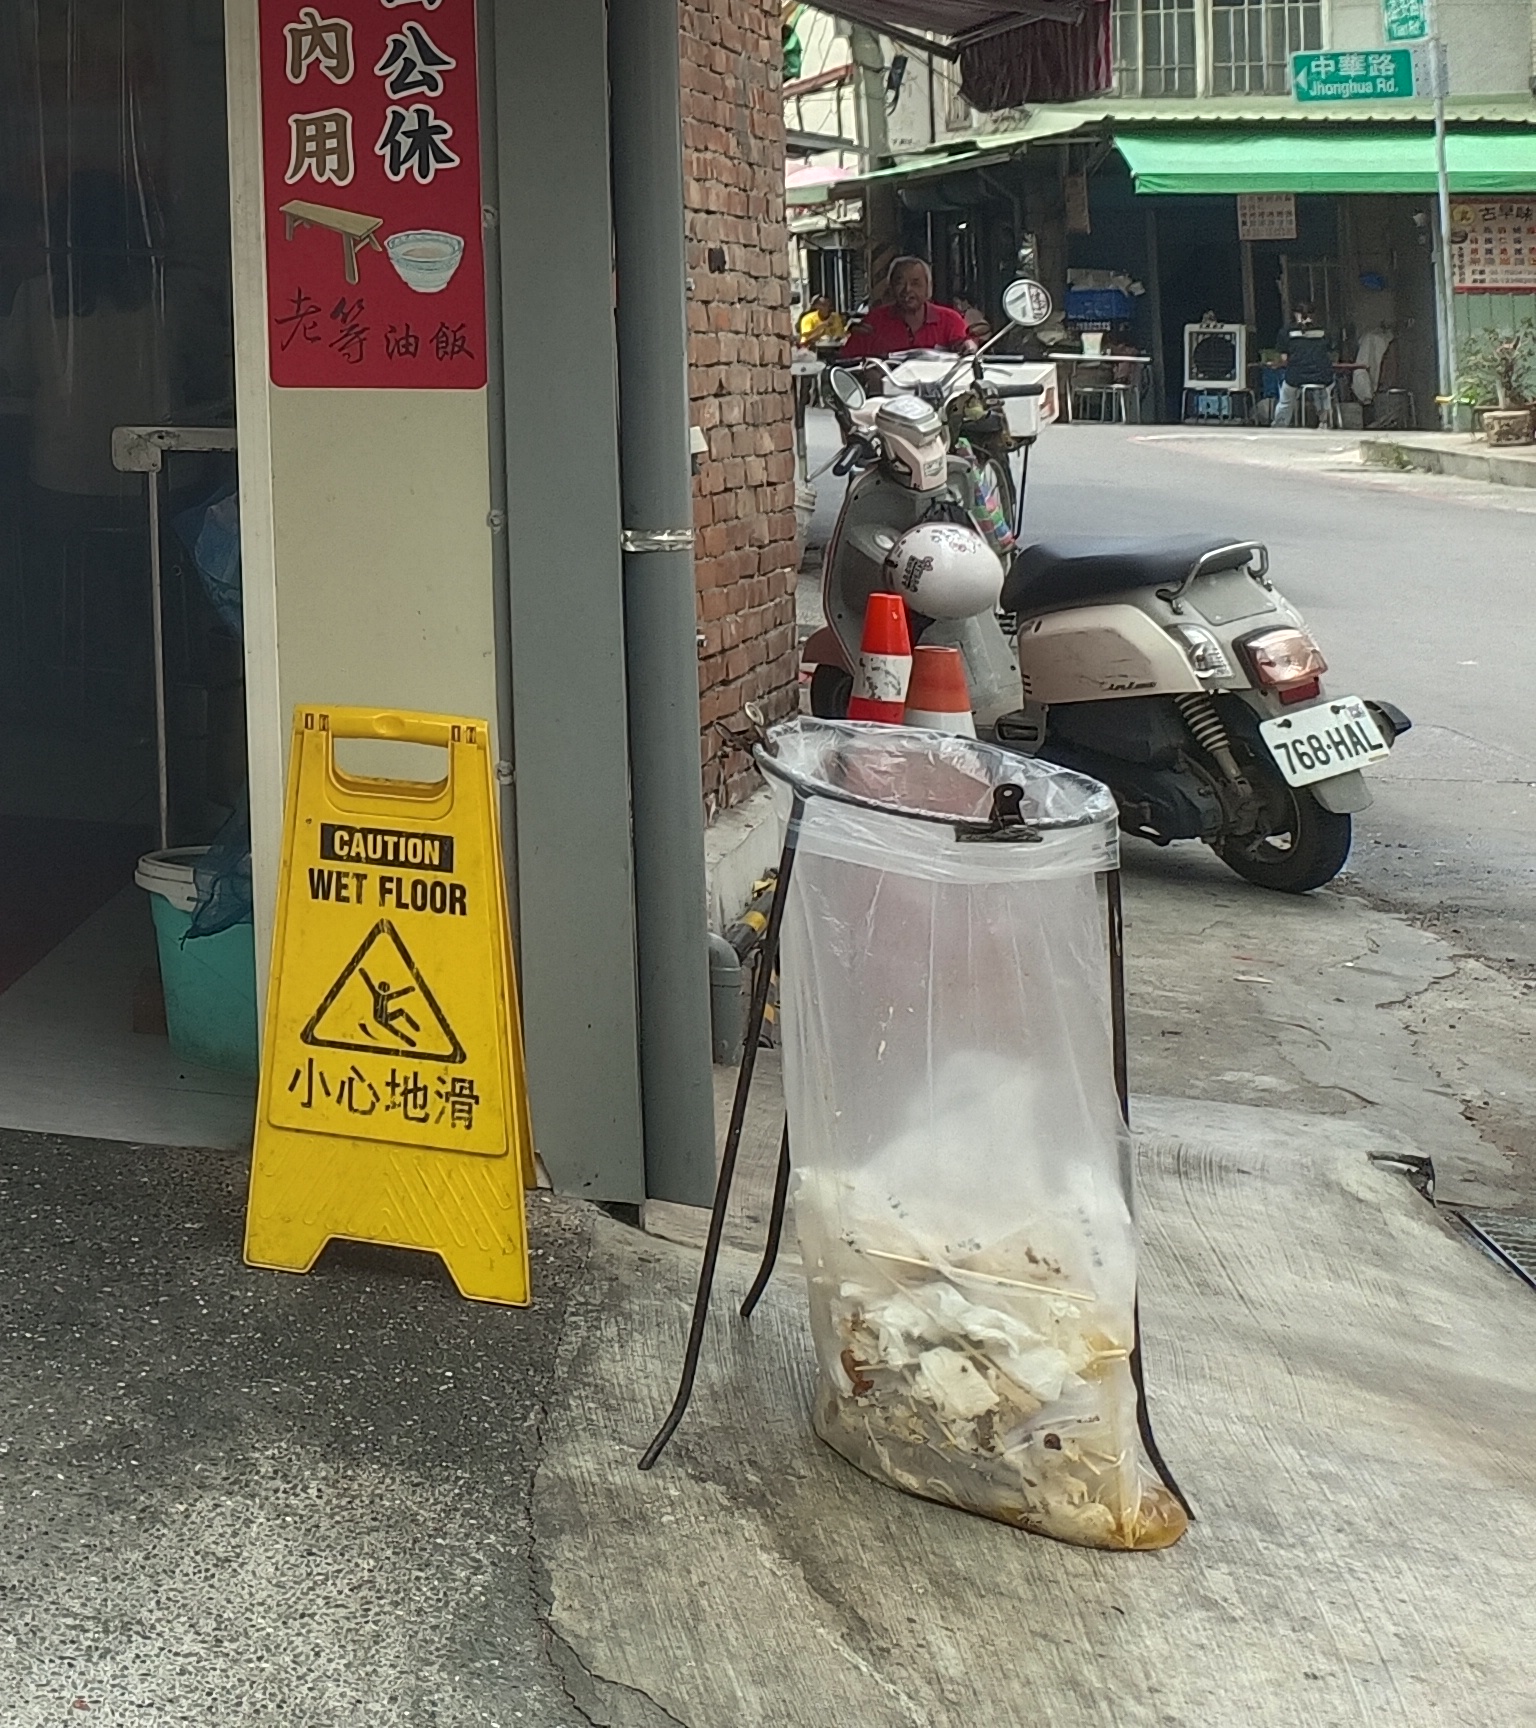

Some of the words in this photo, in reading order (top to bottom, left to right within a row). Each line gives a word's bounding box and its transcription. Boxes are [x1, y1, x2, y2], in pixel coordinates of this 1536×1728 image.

[1310, 53, 1396, 78] 中華路
[1309, 80, 1374, 98] Jhonghua
[1376, 79, 1399, 94] Rd.
[333, 829, 441, 866] CAUTION
[308, 868, 366, 905] WET
[378, 874, 467, 916] FLOOR
[288, 1057, 480, 1131] 小心地滑
